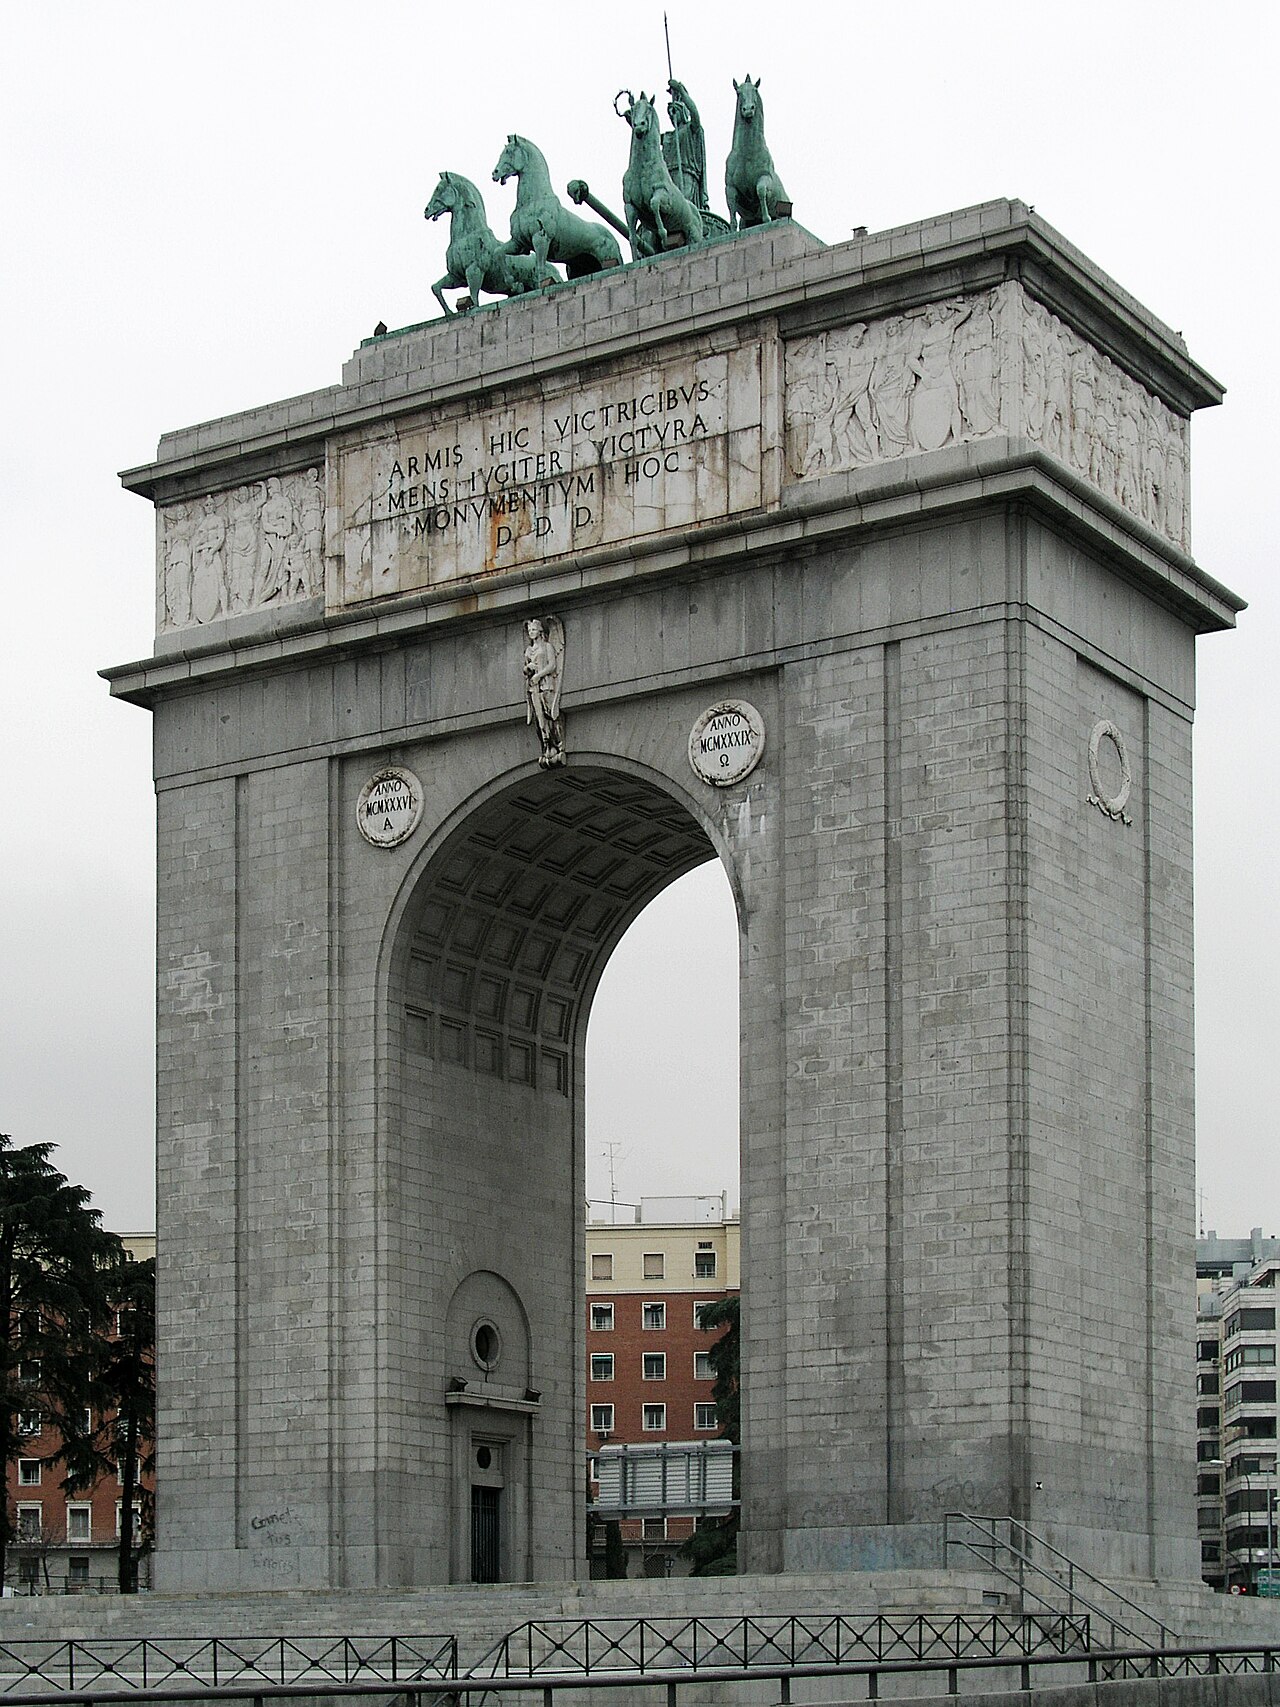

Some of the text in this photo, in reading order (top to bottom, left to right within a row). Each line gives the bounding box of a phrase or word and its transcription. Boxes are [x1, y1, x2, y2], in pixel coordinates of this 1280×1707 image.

[389, 380, 709, 481] ARMIS HIC VICTRICIBVS
[388, 414, 709, 513] MENS IVGITER VICTVRA
[414, 451, 679, 537] MONVMENTVM HOC
[710, 714, 741, 731] ANNO
[700, 729, 752, 754] MCMXXXIX
[719, 754, 730, 767] Ω
[374, 780, 402, 796] ANNO
[366, 795, 412, 818] MCMXXXVI
[383, 817, 393, 830] A
